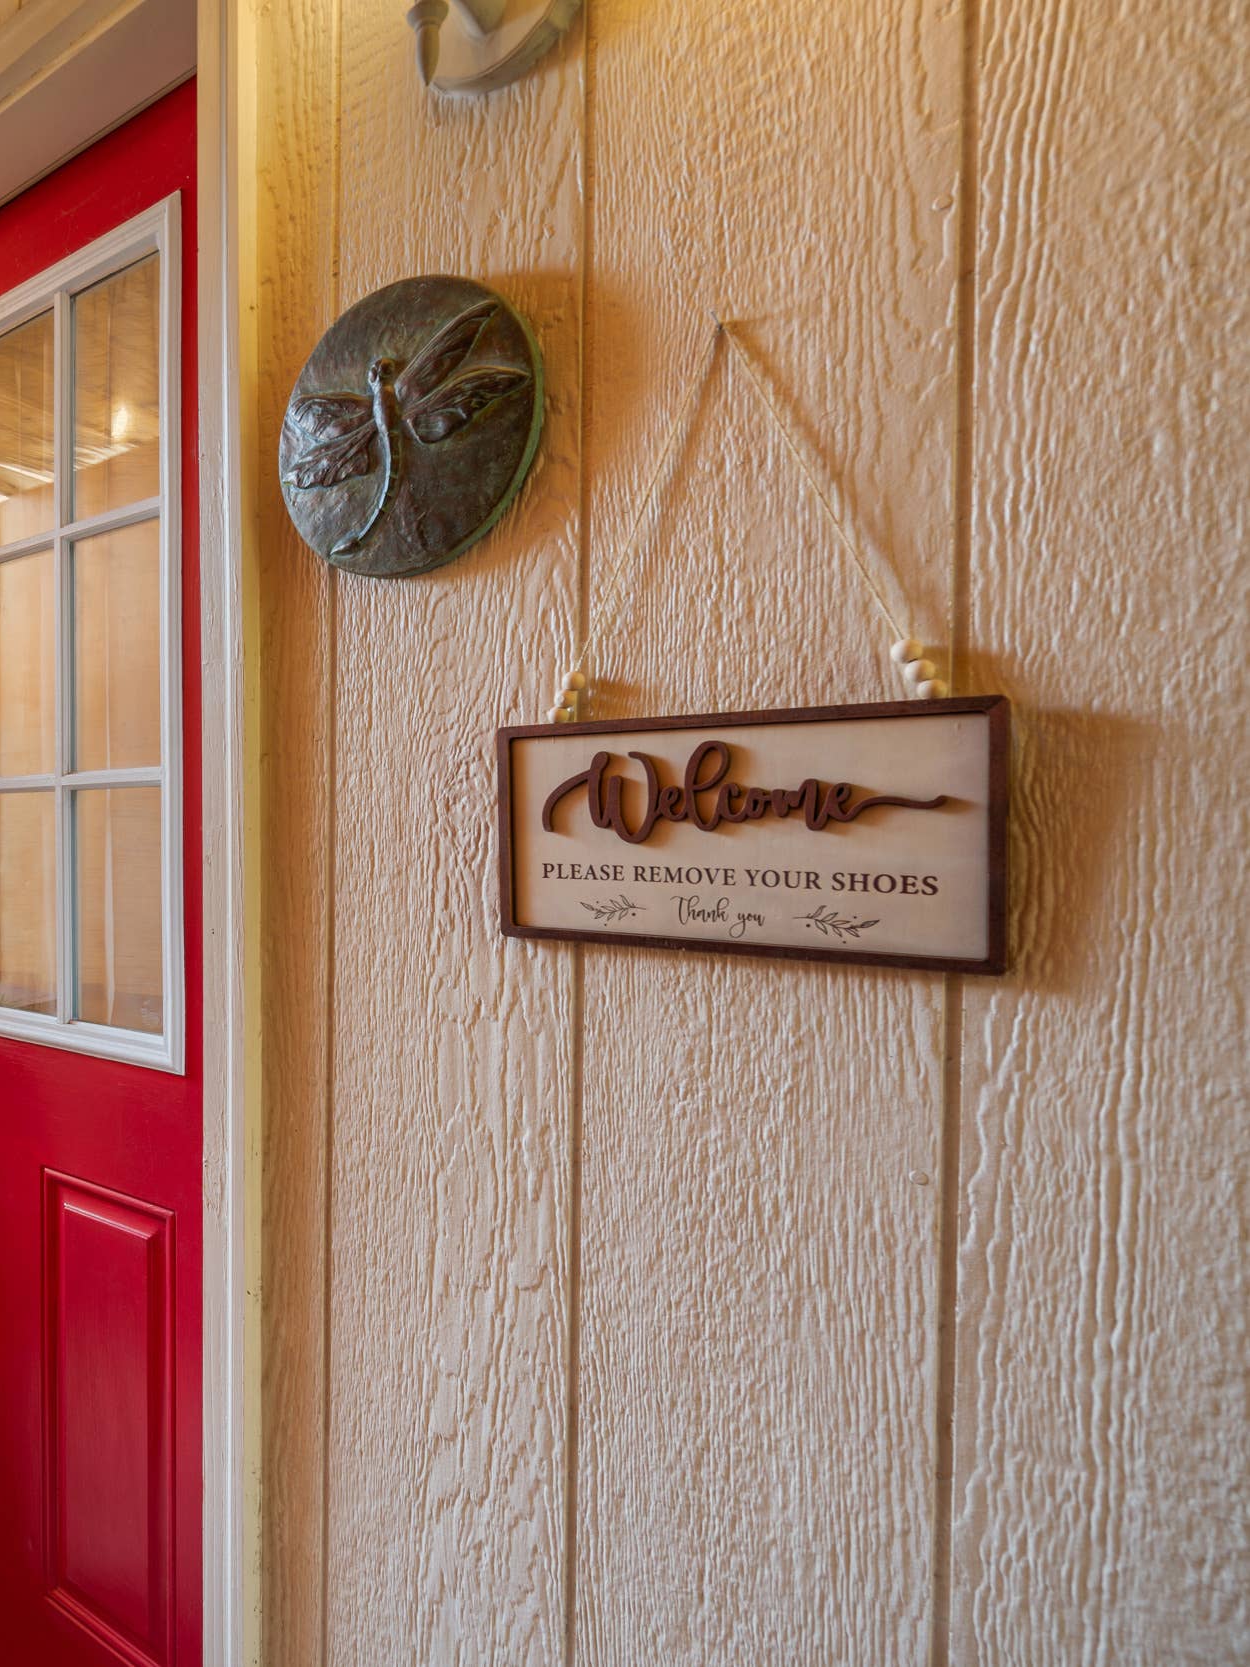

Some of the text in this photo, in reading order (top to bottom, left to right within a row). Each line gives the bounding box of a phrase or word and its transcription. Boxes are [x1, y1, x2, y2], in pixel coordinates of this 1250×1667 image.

[541, 740, 949, 844] Welcome
[541, 862, 939, 896] PLEASE REMOVE YOUR SHOES
[669, 895, 765, 938] Thank you
